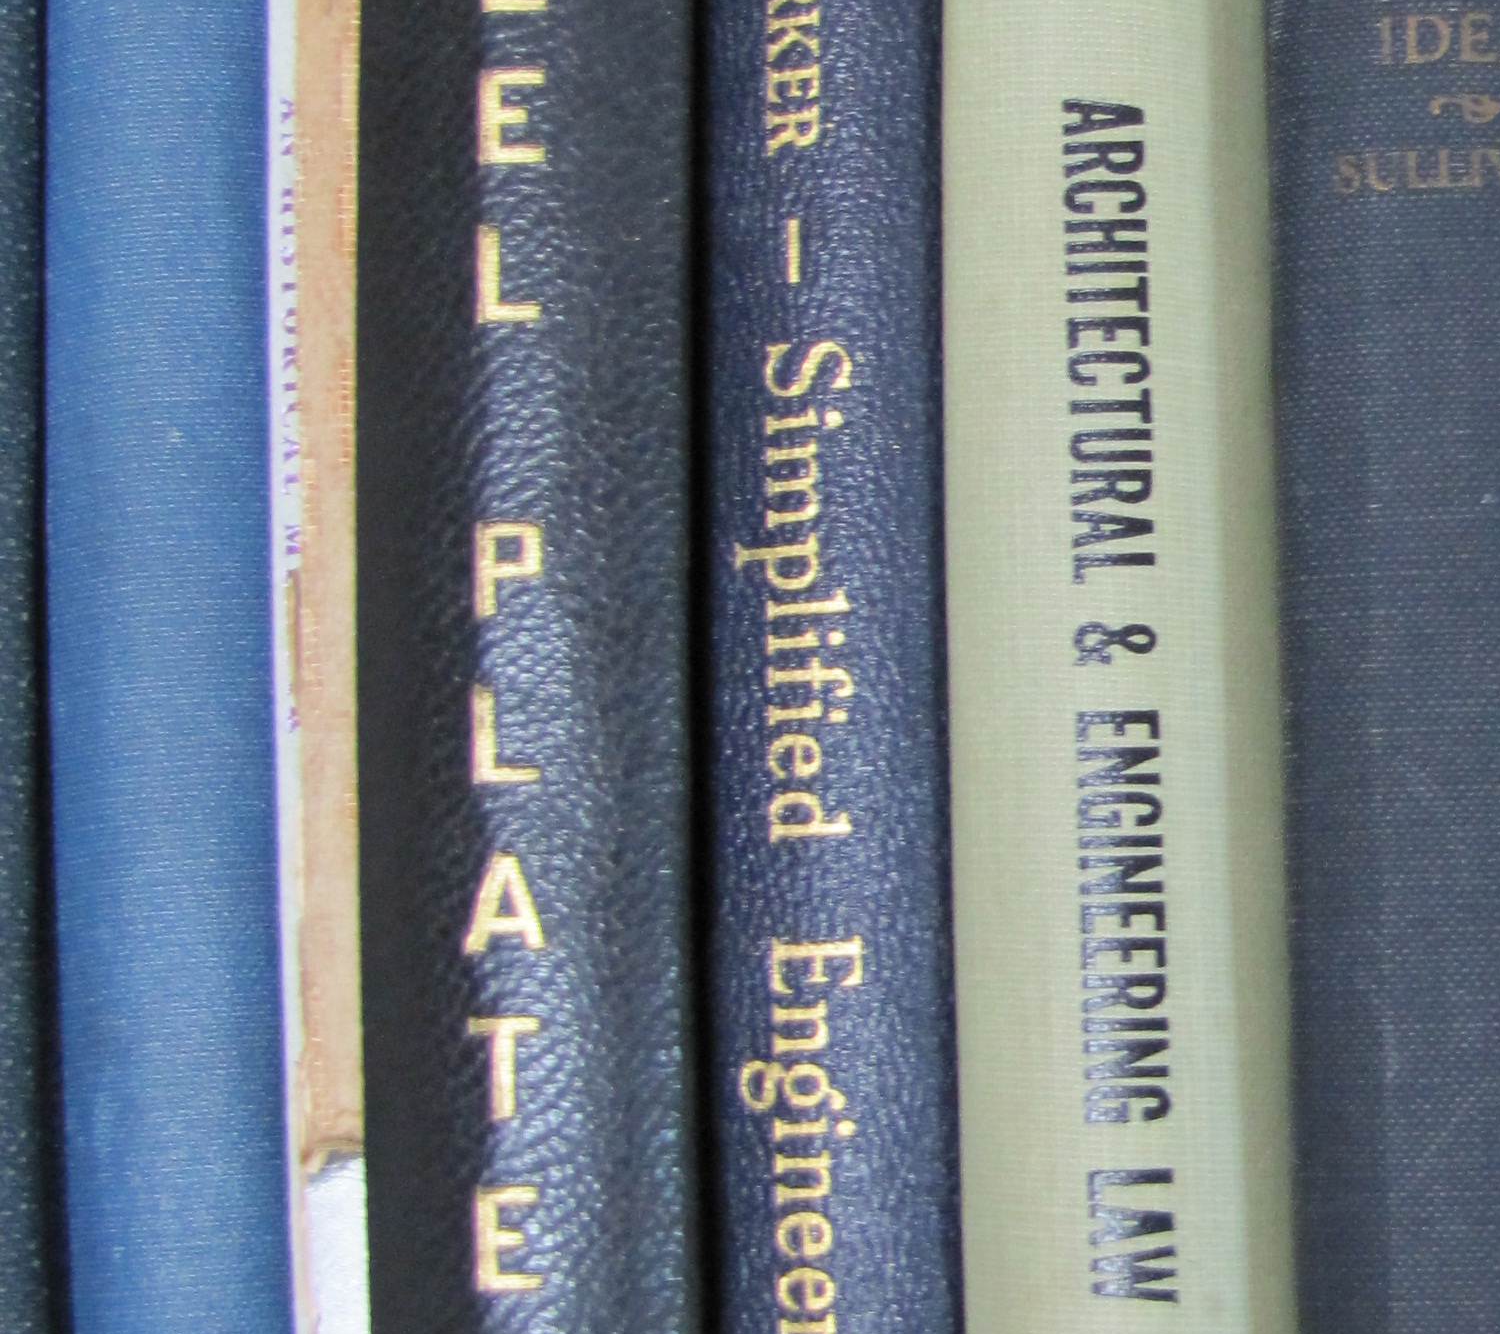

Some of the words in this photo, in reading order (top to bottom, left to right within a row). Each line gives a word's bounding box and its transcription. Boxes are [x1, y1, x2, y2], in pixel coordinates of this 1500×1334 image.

[1062, 99, 1156, 585] ARCHITECTURAL
[735, 341, 853, 843] Simplified
[1072, 621, 1157, 666] &
[1075, 709, 1173, 1124] ENGINEERING
[1087, 1167, 1179, 1303] LAW
